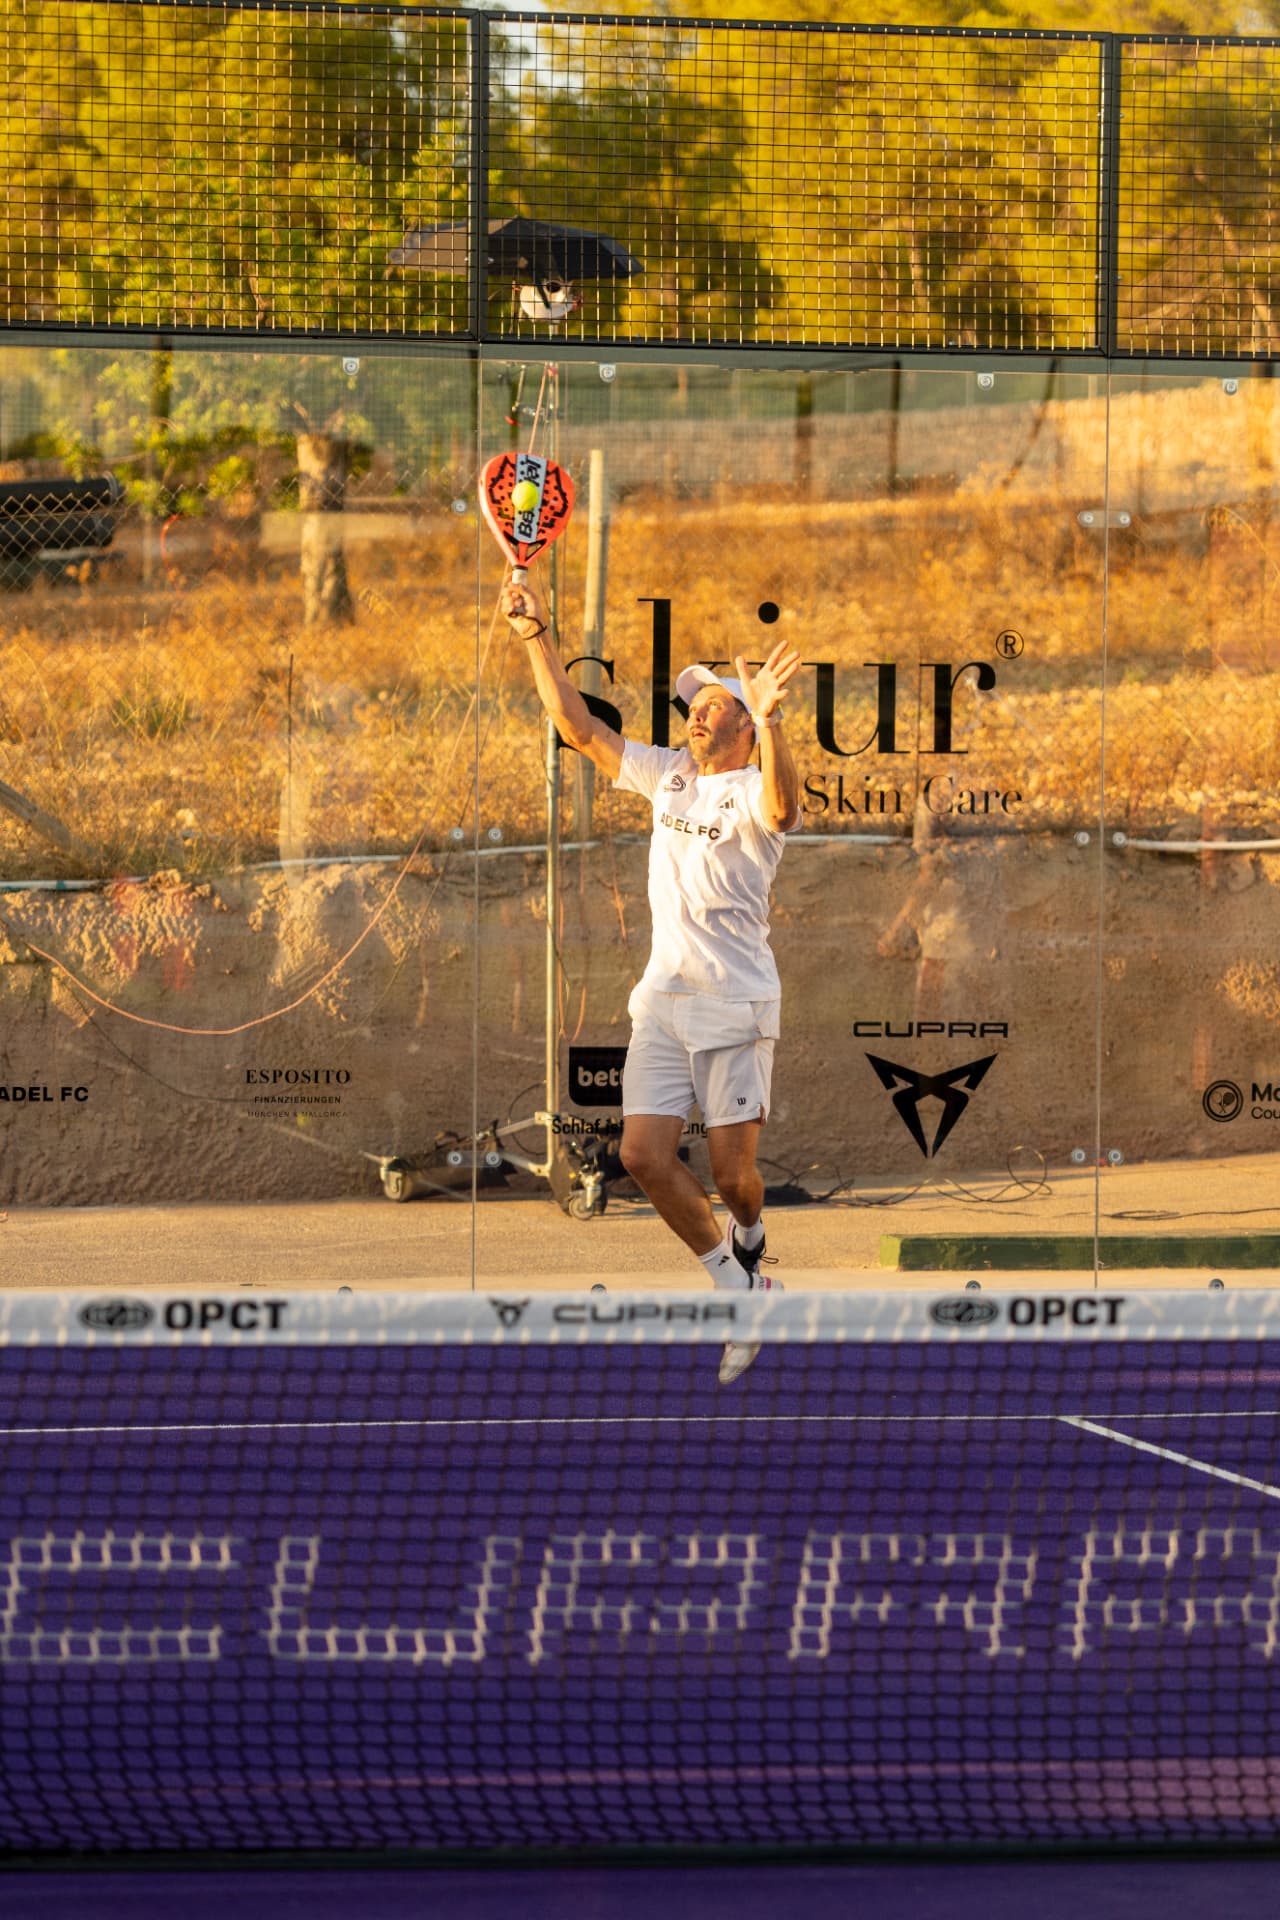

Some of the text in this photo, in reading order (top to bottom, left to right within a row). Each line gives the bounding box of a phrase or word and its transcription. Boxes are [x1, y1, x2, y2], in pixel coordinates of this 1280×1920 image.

[803, 775, 1023, 815] Skin Care
[698, 825, 721, 841] FC
[853, 1021, 1009, 1039] CUPRA
[246, 1069, 351, 1084] ESPOSITO
[0, 1086, 89, 1102] ADEL FC
[254, 1095, 341, 1104] FINANZIERUNGEN
[551, 1118, 601, 1136] Schlaf
[163, 1299, 287, 1331] OPCT
[552, 1303, 737, 1324] CUPRA
[1008, 1297, 1126, 1326] OPCT
